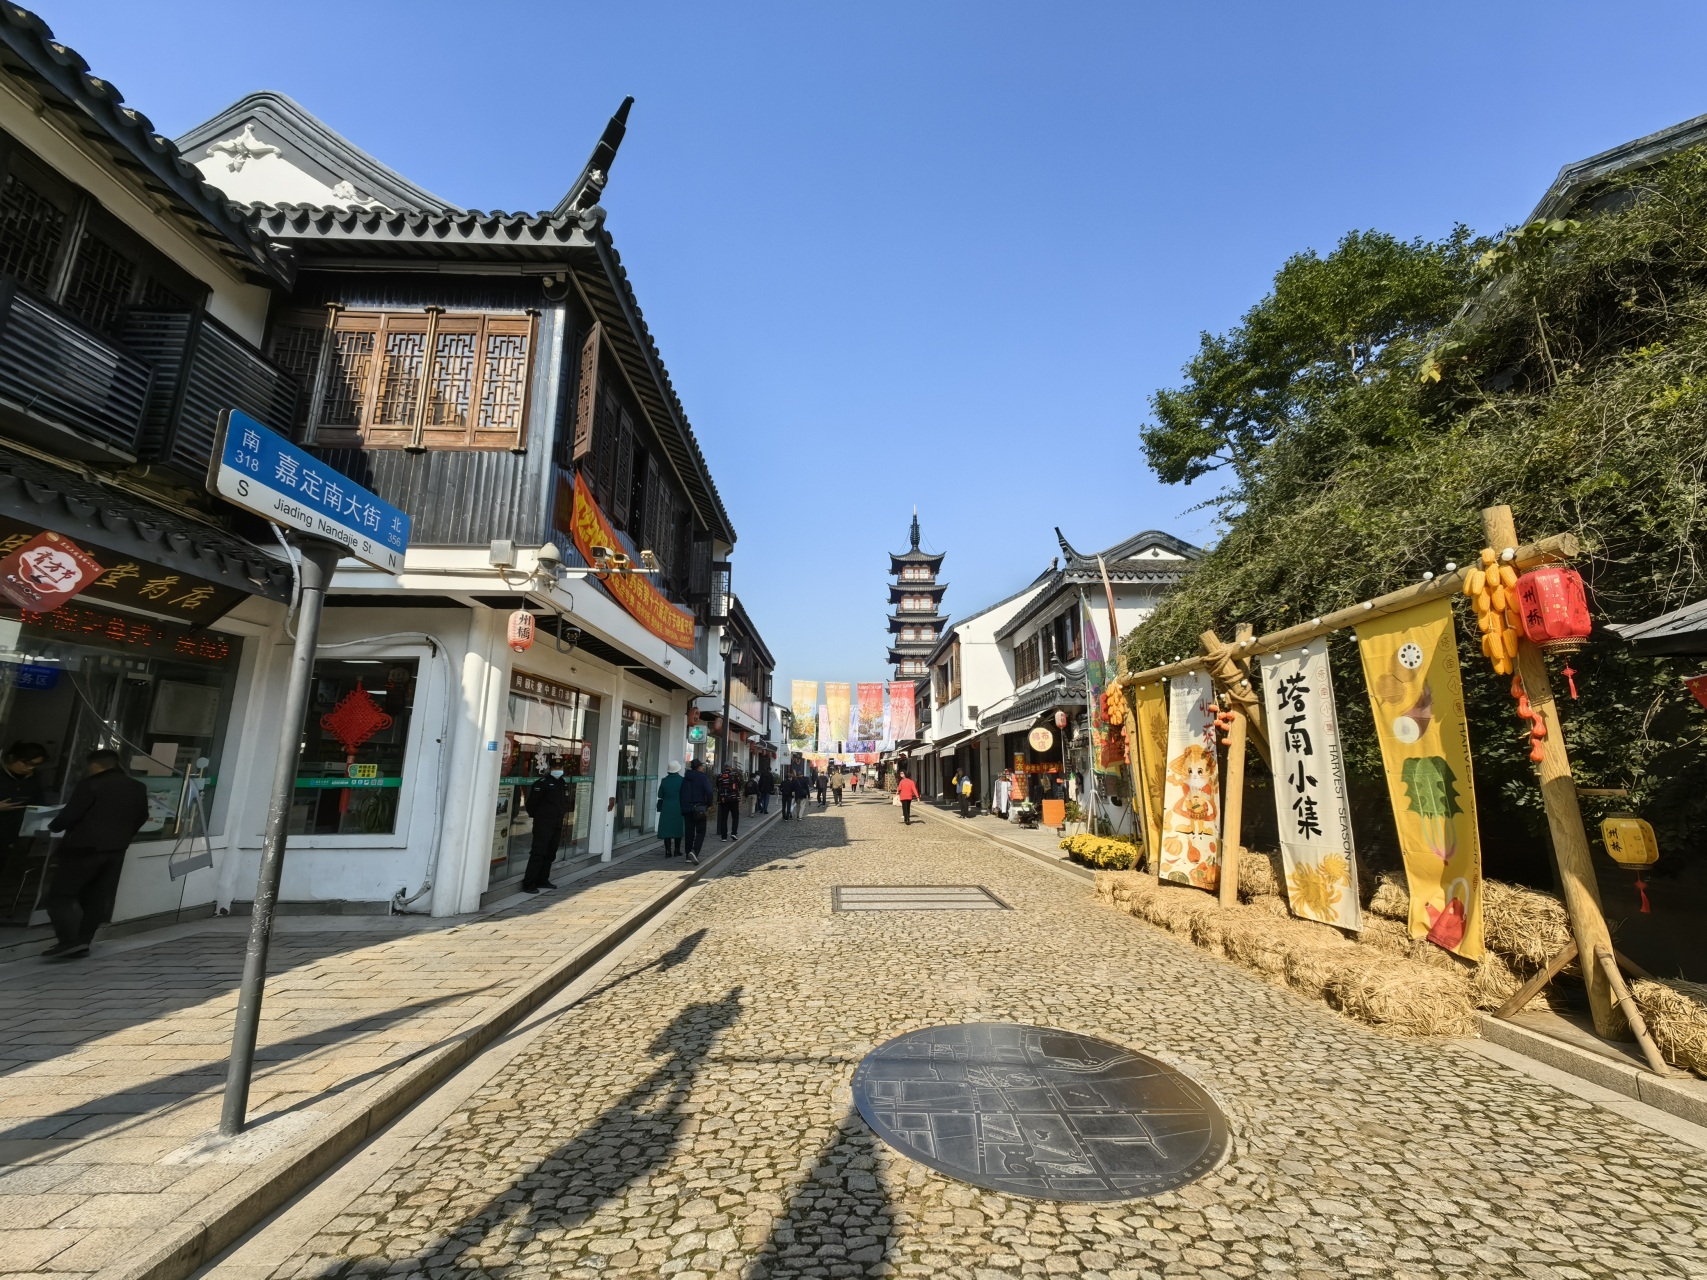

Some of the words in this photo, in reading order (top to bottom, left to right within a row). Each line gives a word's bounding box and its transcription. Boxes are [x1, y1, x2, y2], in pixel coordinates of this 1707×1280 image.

[242, 428, 261, 453] 南
[235, 450, 259, 472] 318
[237, 479, 249, 496] S
[275, 452, 382, 532] 嘉定南大街
[274, 499, 313, 528] Jiading
[318, 519, 358, 547] Nandajie
[362, 541, 374, 555] St.
[391, 516, 401, 533] 北
[387, 532, 401, 547] 356
[34, 551, 76, 579] 膏方节
[388, 553, 396, 568] N
[1522, 586, 1543, 627] 州桥
[1277, 671, 1322, 840] 塔南小集
[1329, 744, 1344, 799] HARVEST
[1338, 807, 1352, 861] SEASON
